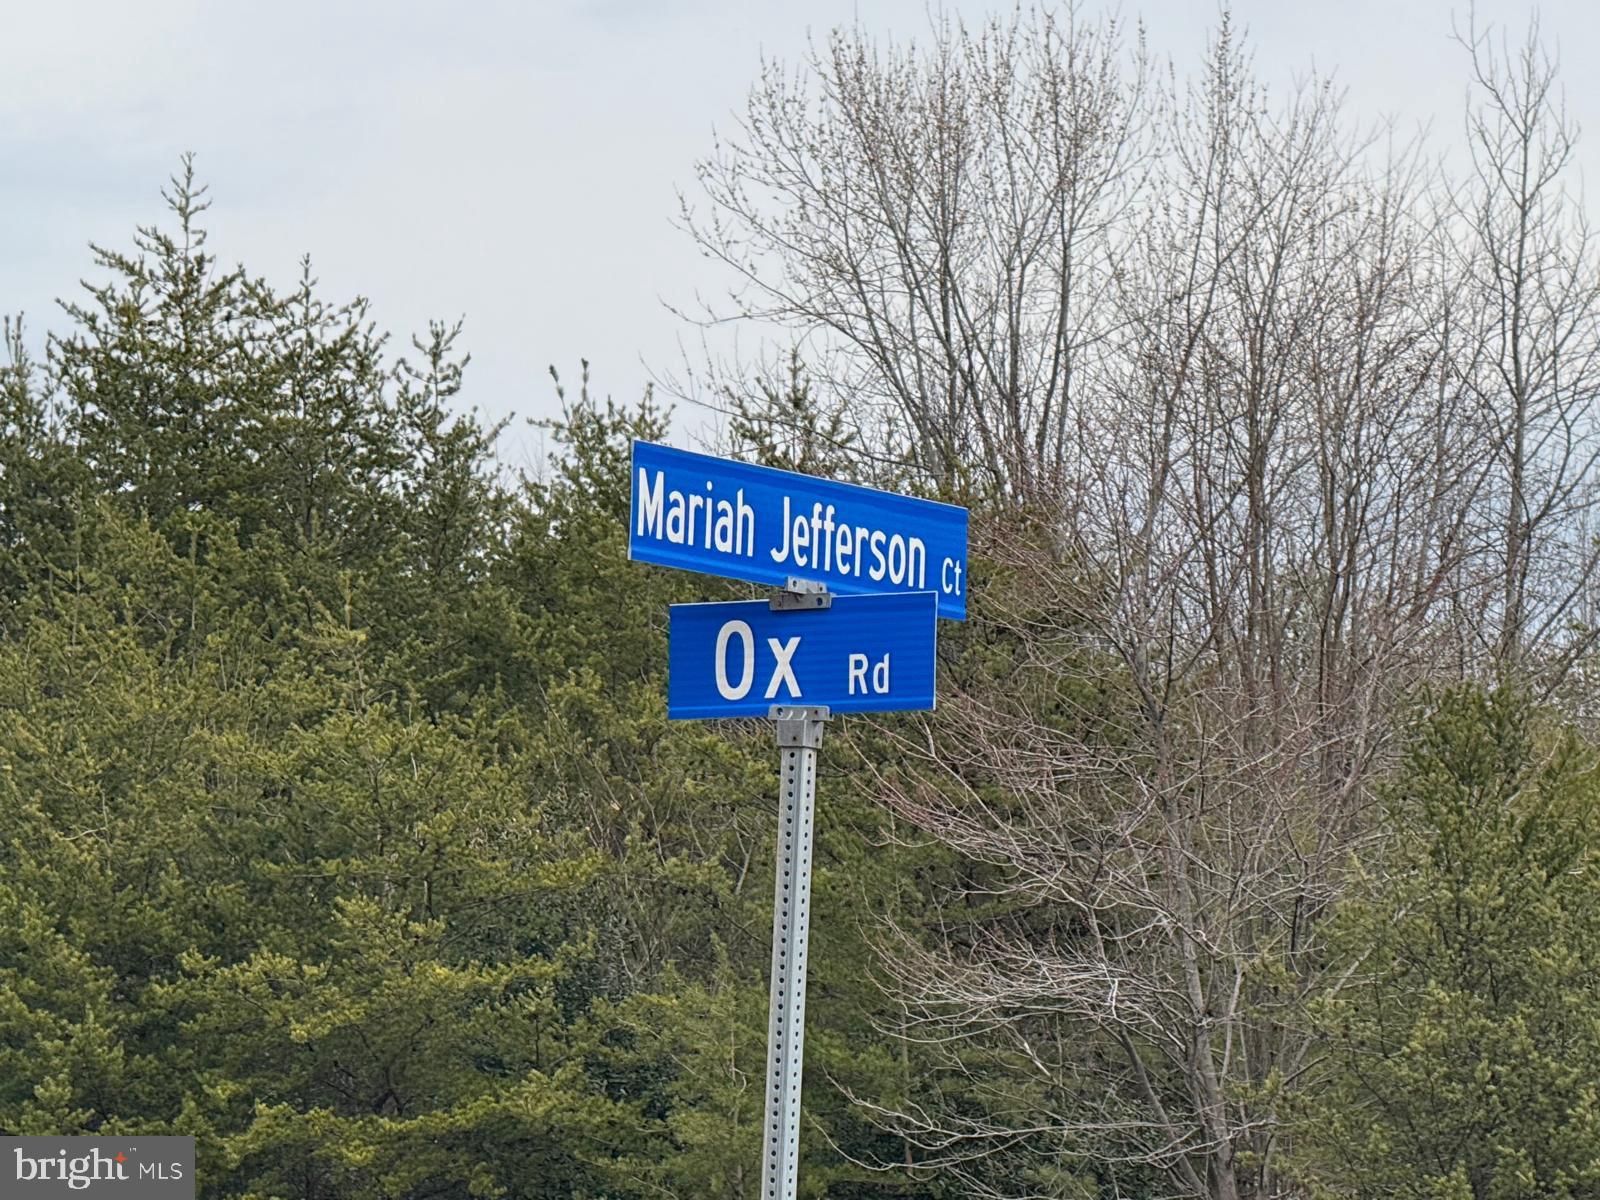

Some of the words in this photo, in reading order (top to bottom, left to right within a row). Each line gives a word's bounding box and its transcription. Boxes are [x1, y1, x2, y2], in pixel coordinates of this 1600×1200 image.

[637, 467, 755, 557] Mariah
[770, 496, 926, 589] Jefferson
[941, 557, 962, 596] Ct
[715, 620, 802, 701] Ox
[848, 652, 890, 695] Rd
